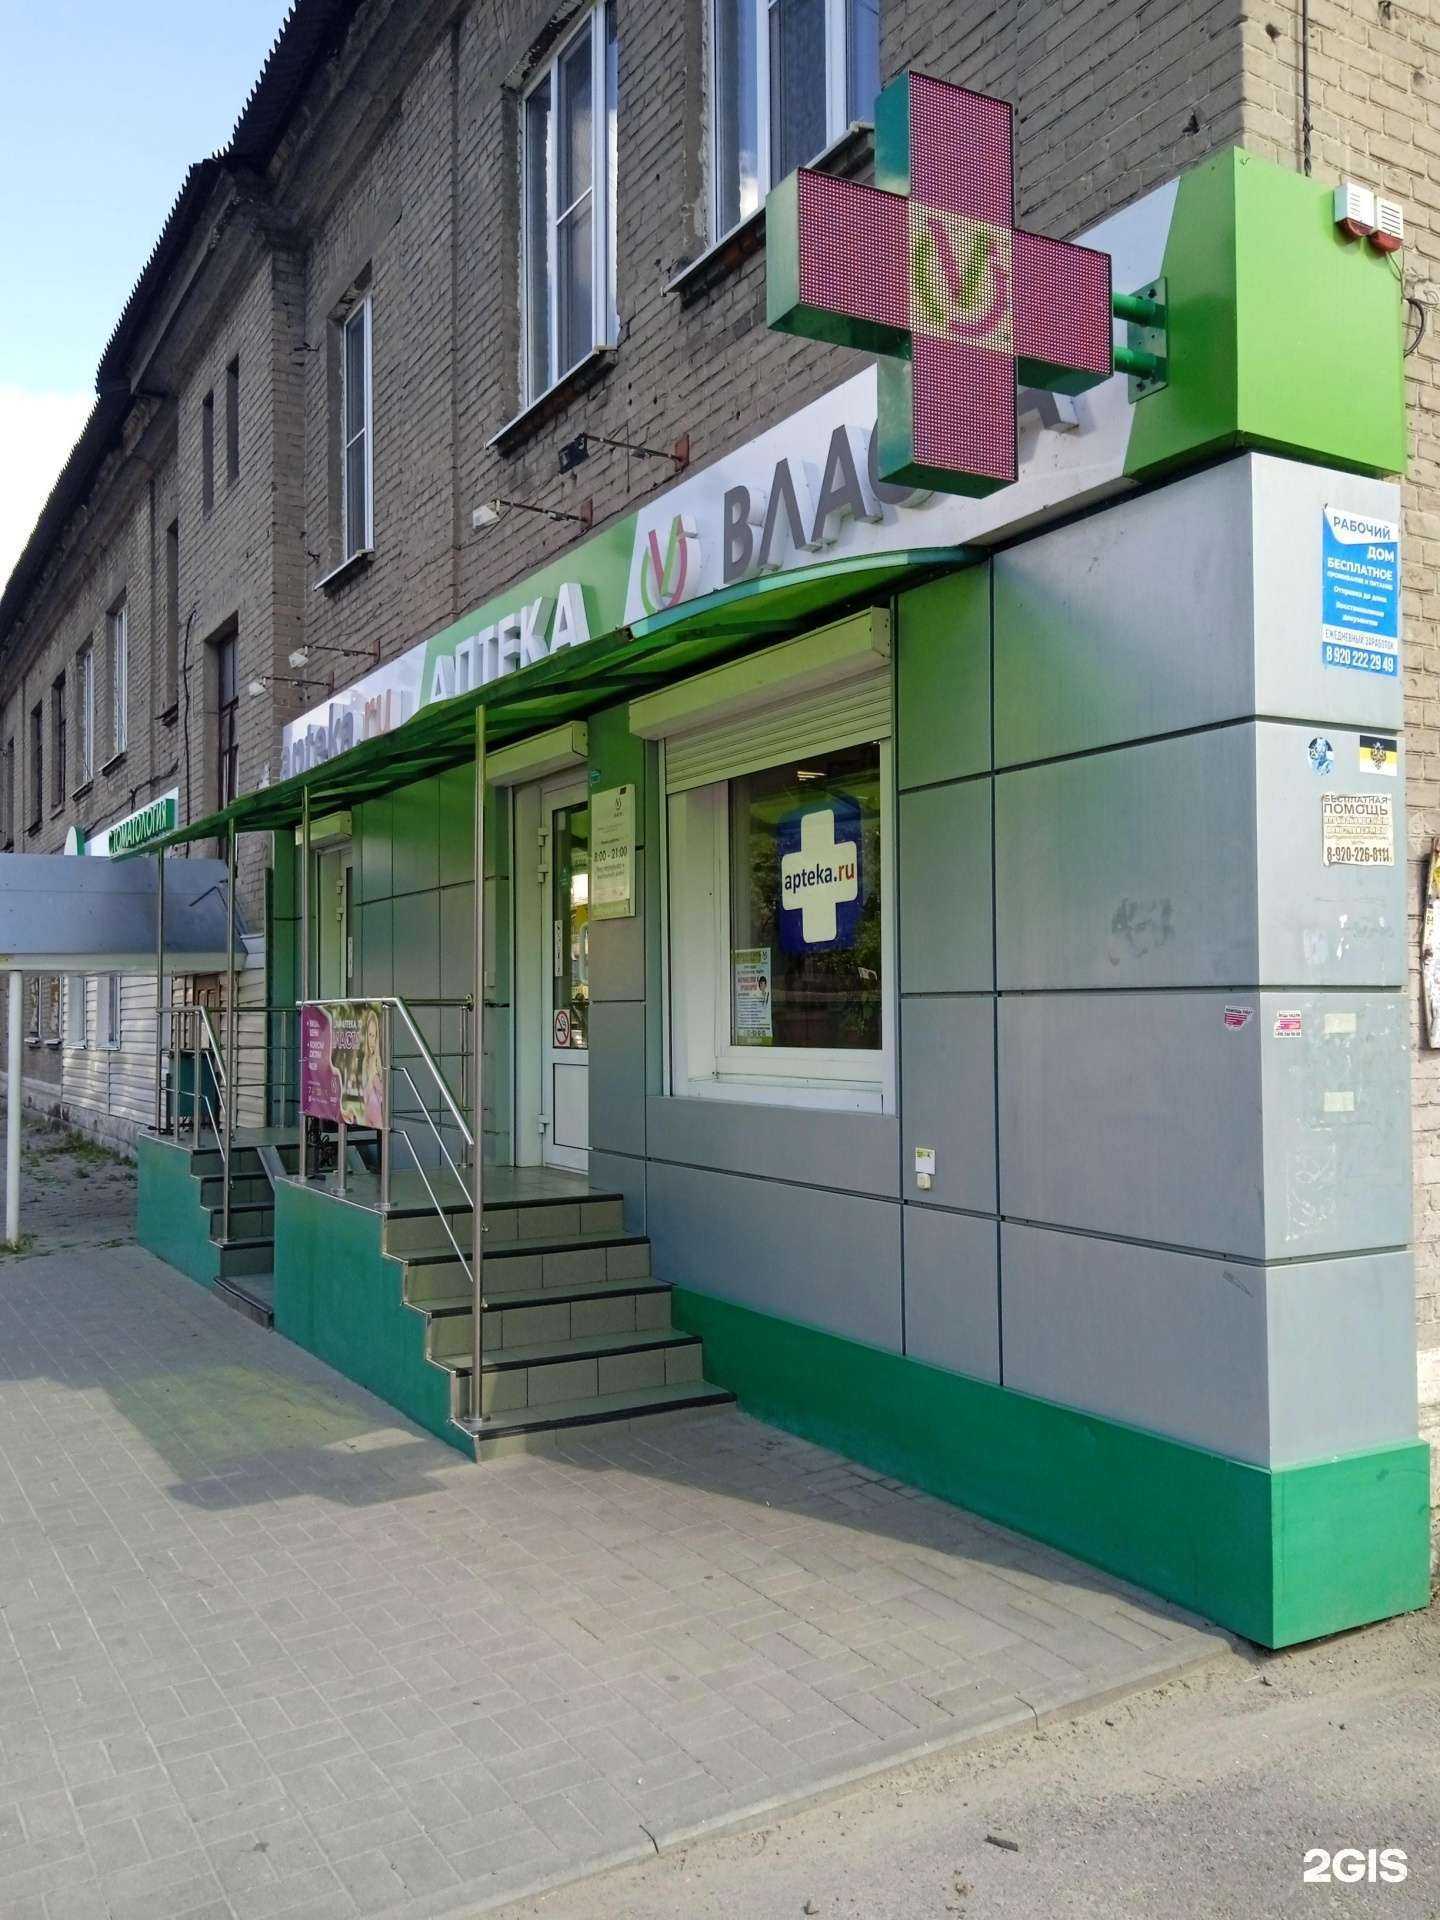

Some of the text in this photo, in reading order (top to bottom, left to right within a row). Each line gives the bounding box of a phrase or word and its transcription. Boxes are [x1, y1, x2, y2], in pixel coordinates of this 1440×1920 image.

[1333, 516, 1391, 540] РАБОЧИЙ
[1367, 546, 1394, 563] ДОМ
[1327, 557, 1393, 580] БЕСПЛАТНОЕ
[430, 582, 591, 701] АПТЕКА
[1326, 645, 1333, 661] 8
[1333, 647, 1351, 664] 920
[1352, 651, 1369, 667] 222
[1370, 655, 1381, 670] 29
[1322, 794, 1388, 804] БЕСПЛАТНАЯ
[1323, 803, 1389, 816] ПОМОЩЬ
[108, 800, 167, 856] СТОМАТОЛОГИЯ
[611, 845, 628, 859] 21:00
[784, 863, 855, 894] apteka.ru
